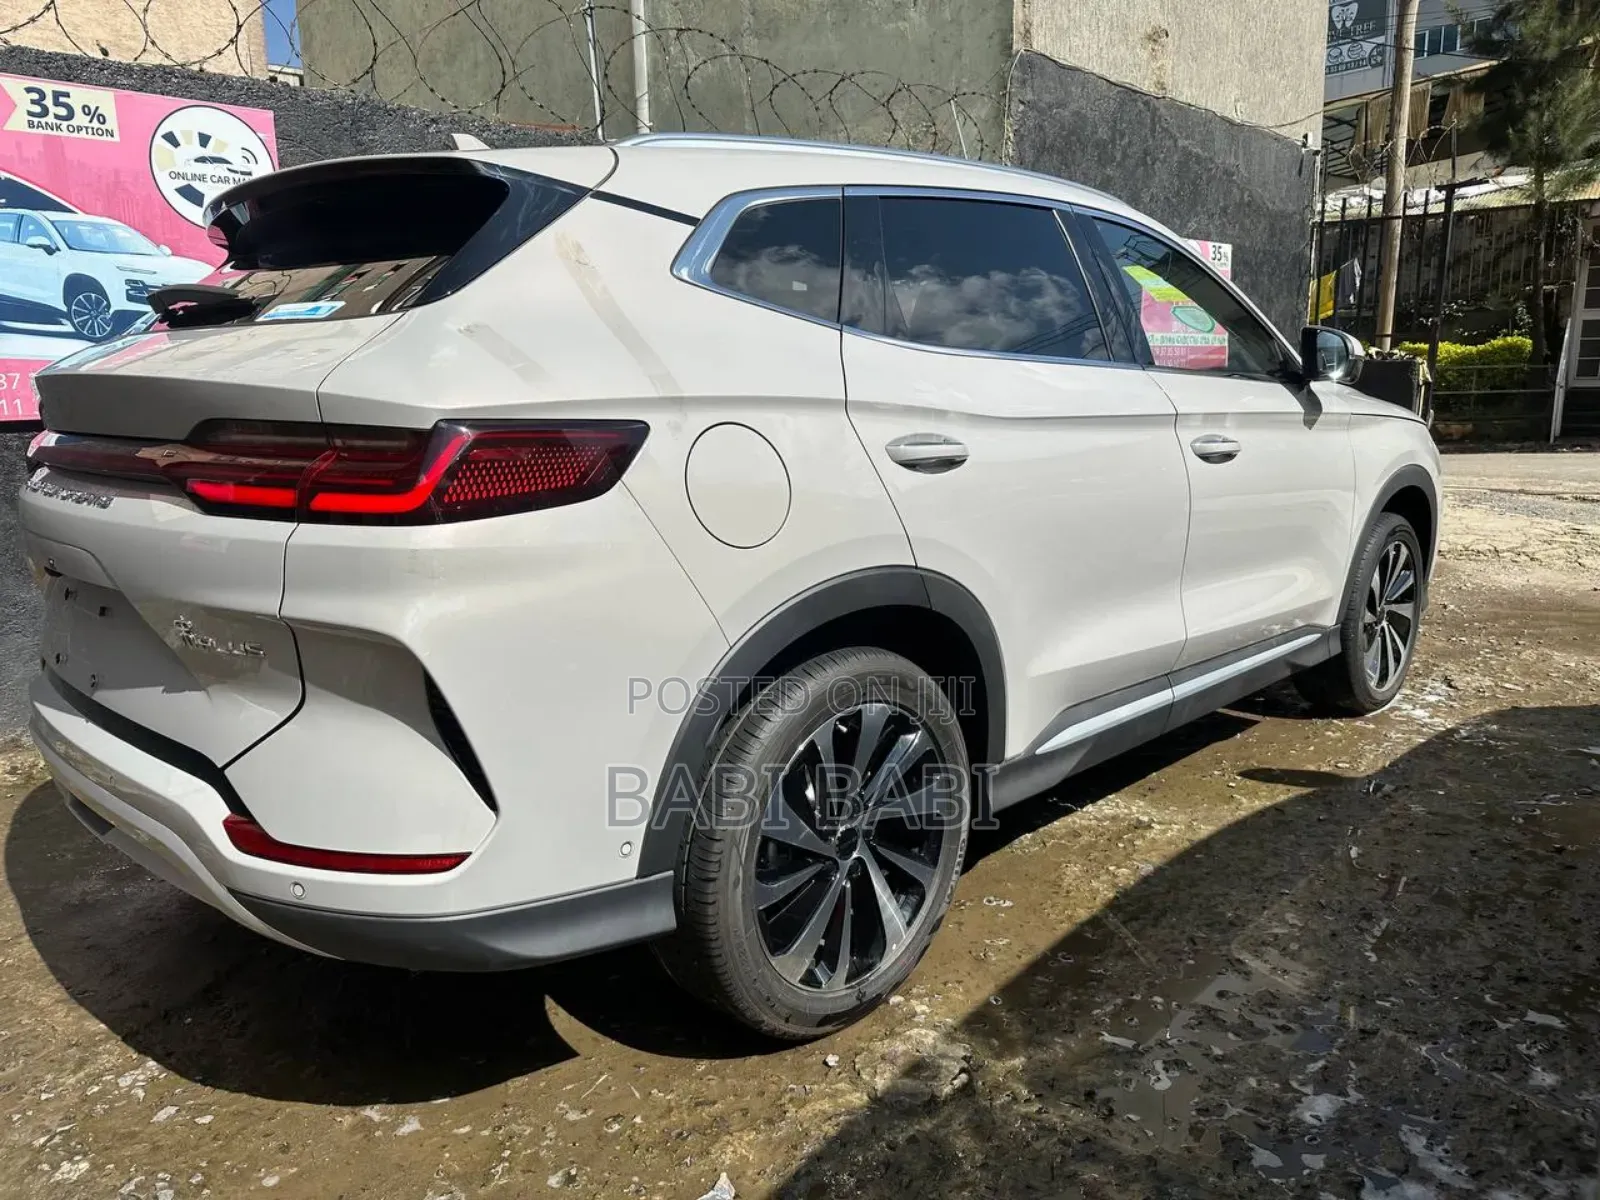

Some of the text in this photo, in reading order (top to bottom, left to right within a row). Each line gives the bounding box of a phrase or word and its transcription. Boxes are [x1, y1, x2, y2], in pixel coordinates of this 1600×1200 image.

[23, 86, 107, 125] 35 %
[27, 119, 115, 138] BANK OPTION
[168, 170, 208, 183] ONLINE
[209, 174, 231, 185] CAR
[1211, 244, 1222, 261] 35
